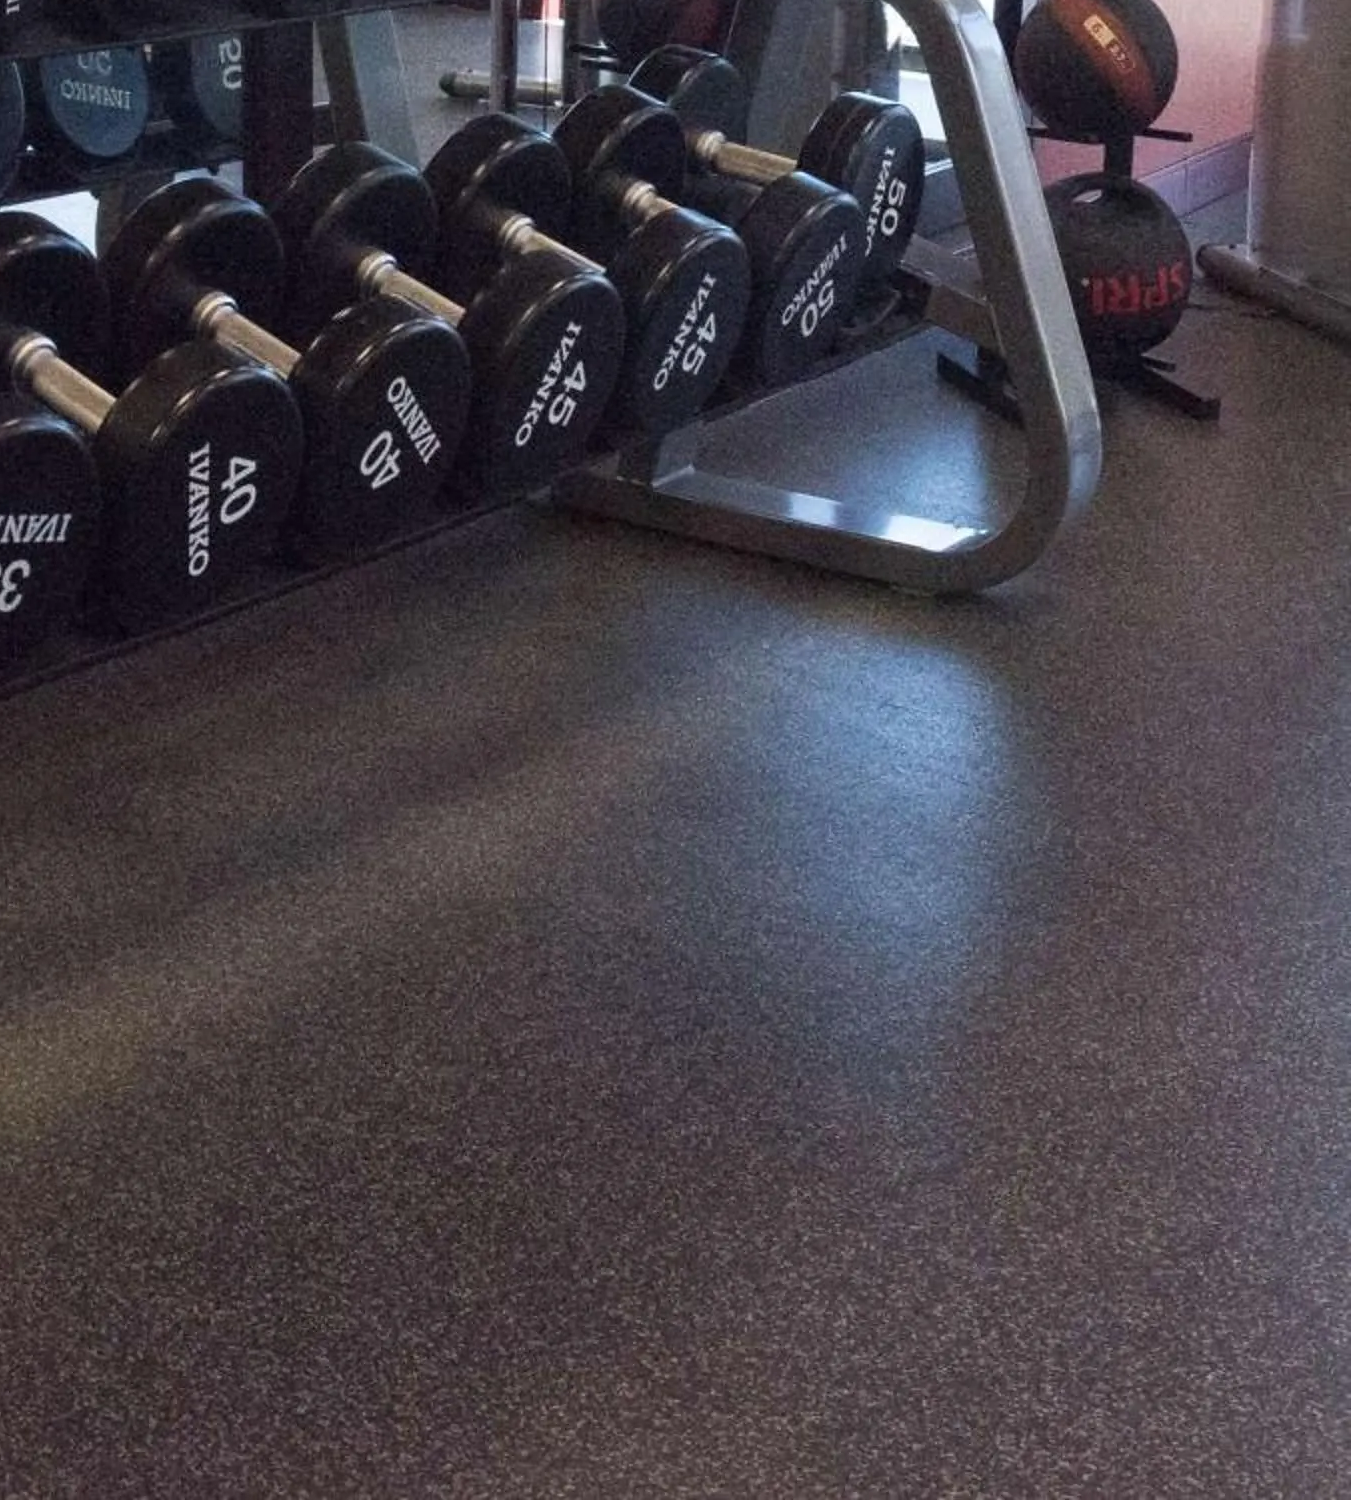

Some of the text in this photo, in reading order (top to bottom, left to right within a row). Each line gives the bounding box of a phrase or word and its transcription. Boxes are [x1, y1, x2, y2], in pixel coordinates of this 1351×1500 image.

[877, 179, 906, 238] 50
[781, 233, 847, 326] IVANKO
[799, 278, 834, 338] 50
[652, 270, 717, 391] IVANKO
[681, 311, 717, 376] 45
[514, 321, 582, 447] IVANKO
[547, 361, 586, 428] 45
[387, 376, 442, 465] IVANKO
[220, 456, 257, 525] 40
[359, 430, 401, 490] 40
[188, 443, 211, 576] IVANKO
